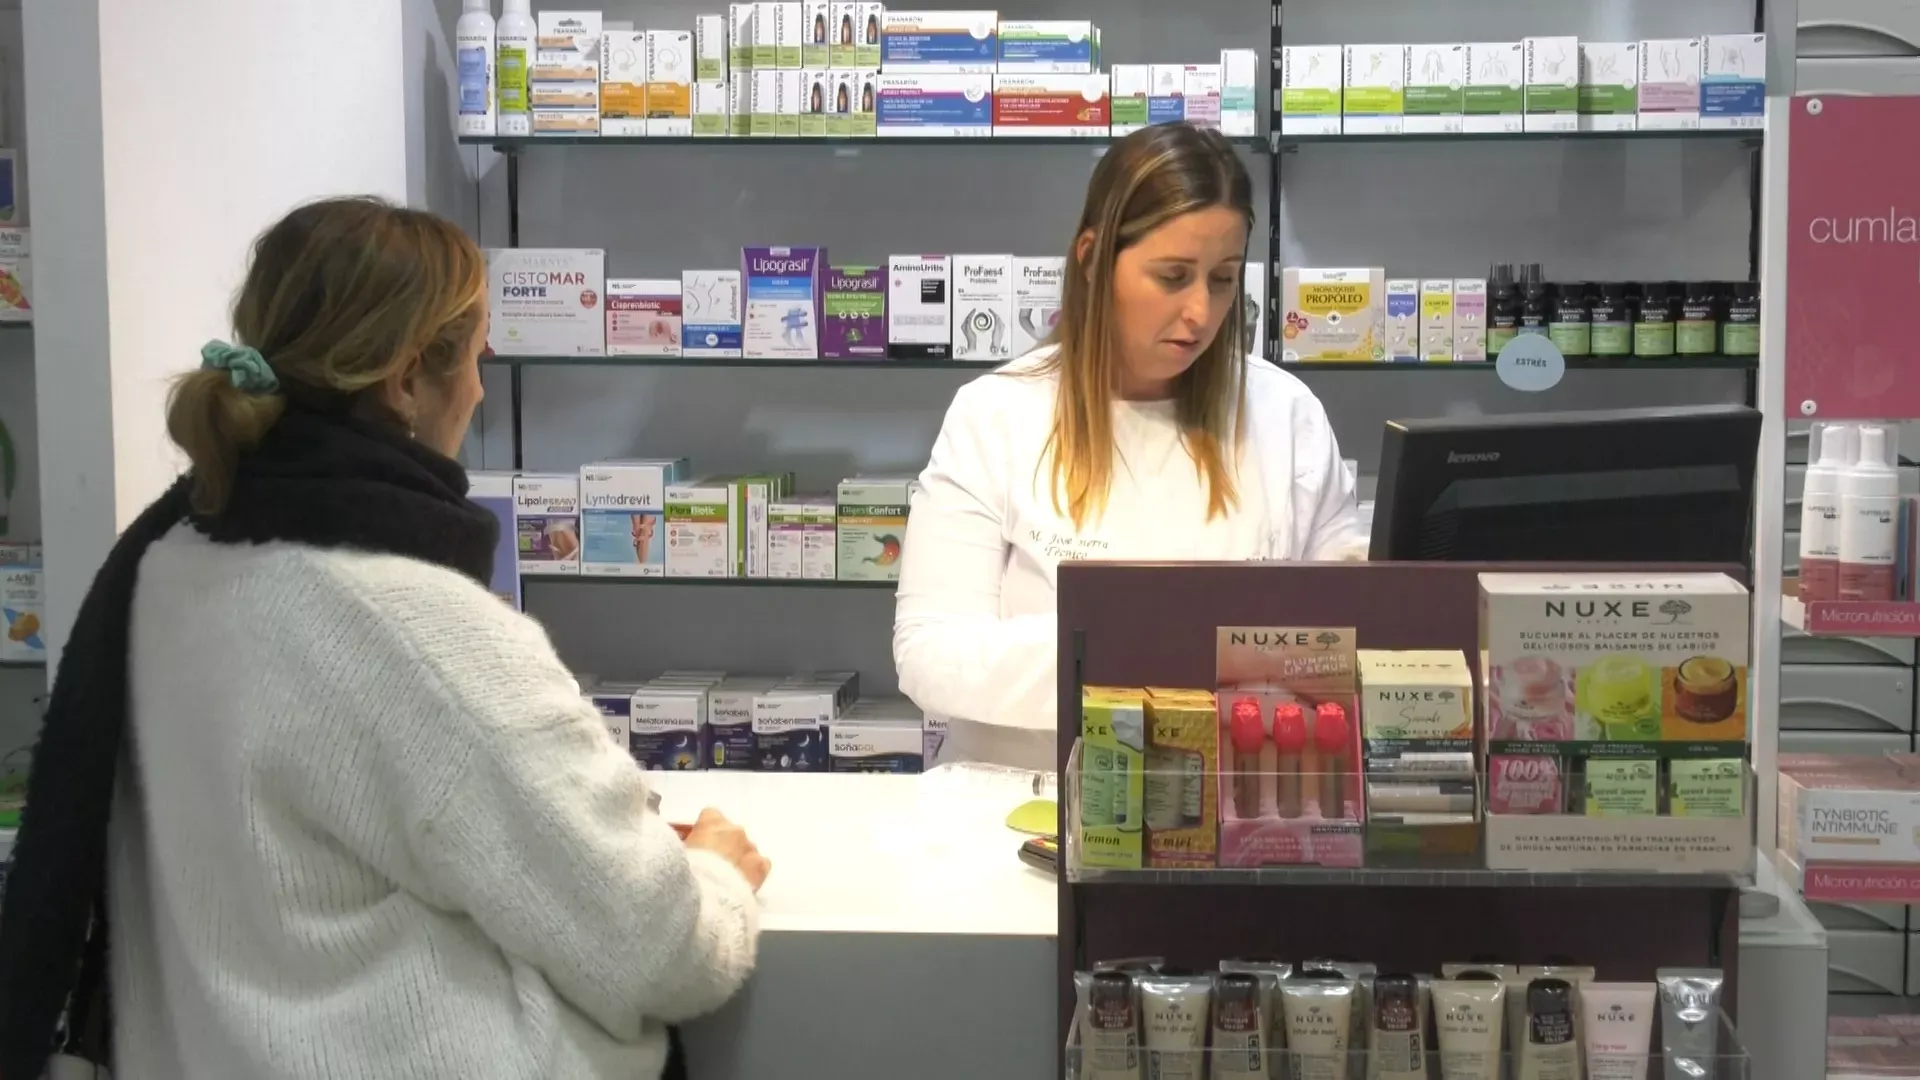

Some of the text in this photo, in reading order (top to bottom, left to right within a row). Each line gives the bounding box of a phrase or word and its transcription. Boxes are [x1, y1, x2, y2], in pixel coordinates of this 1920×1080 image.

[1809, 206, 1920, 243] cumla
[754, 258, 807, 274] Lipograsil
[893, 264, 944, 272] AminoUritis
[502, 272, 585, 286] CISTOMAR
[831, 276, 877, 291] Lipograsil
[503, 286, 547, 298] FORTE
[1306, 290, 1363, 304] PROPÓLEO
[1515, 356, 1547, 368] ESTRÉS
[1447, 450, 1501, 464] lenovo
[586, 492, 651, 507] Lynfodrevit
[1546, 601, 1650, 618] NUXE
[1822, 608, 1915, 624] Micronutrición
[1231, 632, 1309, 646] NUXE
[1522, 642, 1591, 651] DELICIOSOS
[1658, 642, 1672, 651] DE
[1676, 642, 1716, 651] LABIOS
[1380, 691, 1434, 701] NUXE
[1812, 808, 1890, 823] TYNBIOTIC
[1812, 822, 1898, 835] INTIMMUNE
[1084, 832, 1121, 846] lemon
[1155, 1012, 1193, 1021] NUXE
[1296, 1016, 1334, 1024] NUXE
[1446, 1014, 1484, 1022] NUXE
[1598, 1014, 1635, 1022] NUXE
